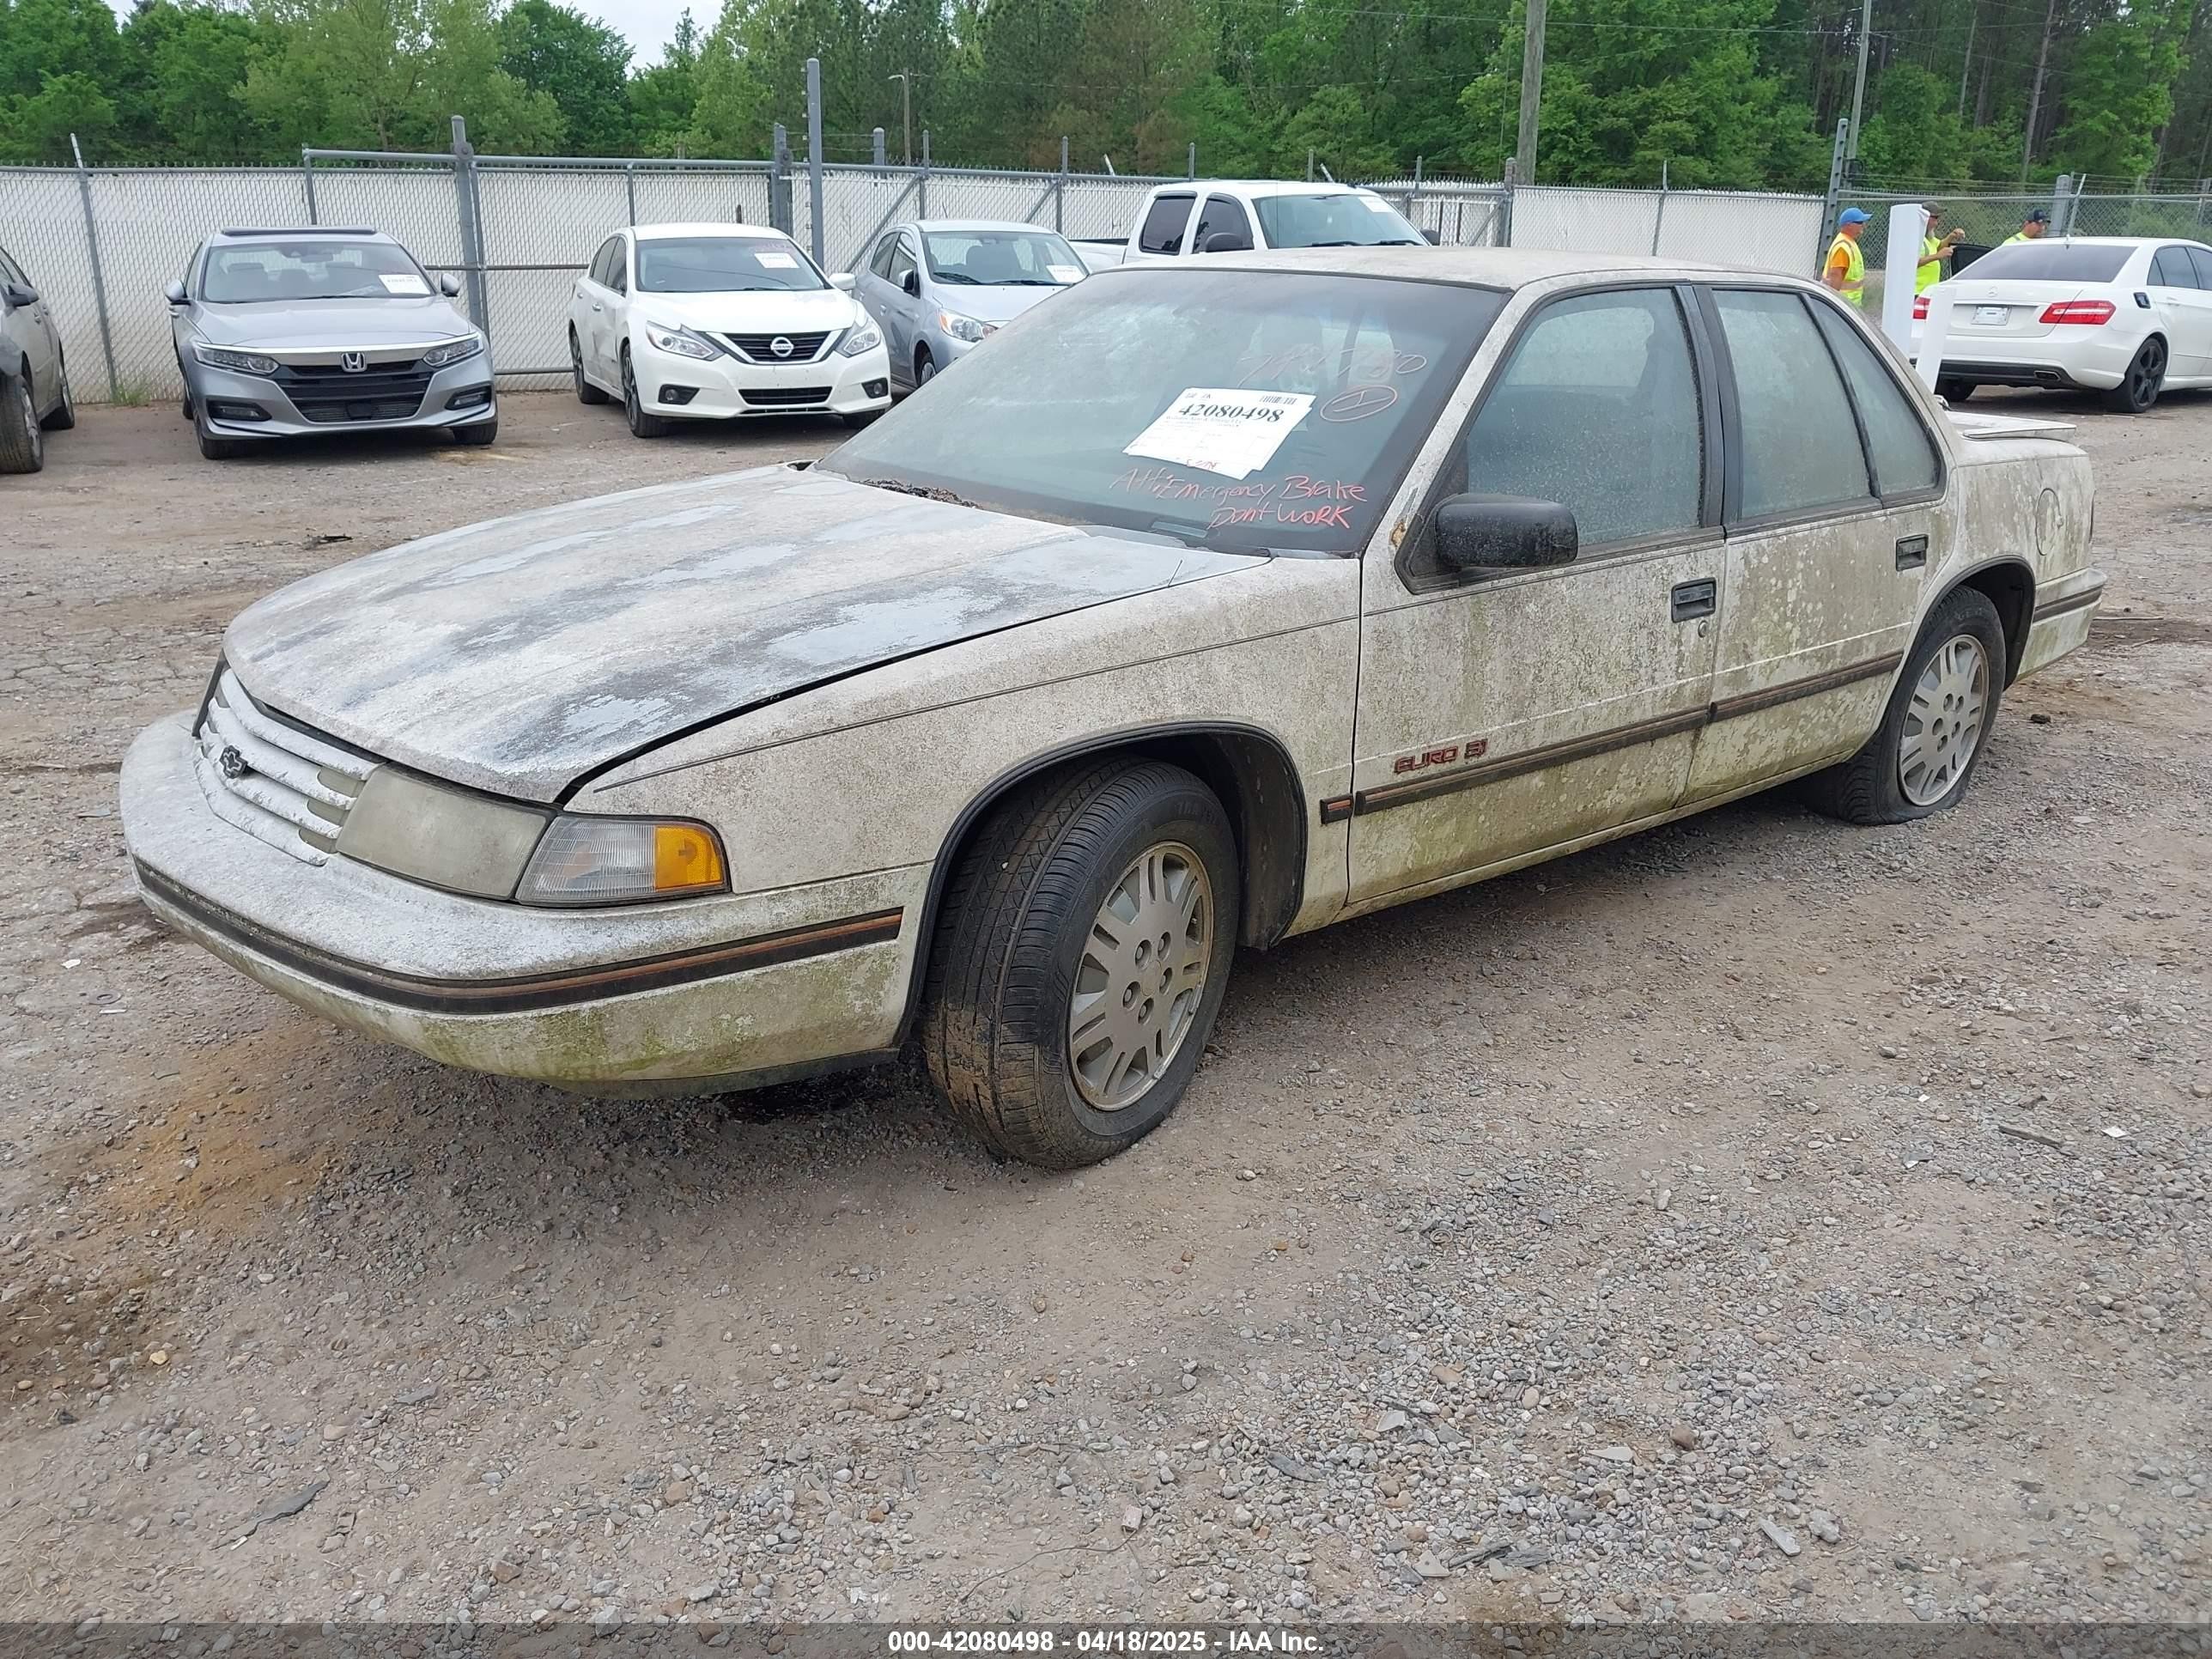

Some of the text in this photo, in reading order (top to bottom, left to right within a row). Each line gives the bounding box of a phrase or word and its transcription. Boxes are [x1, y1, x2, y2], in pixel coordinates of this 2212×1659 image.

[1178, 403, 1285, 422] 42080498
[1278, 474, 1368, 502] Brake
[1393, 745, 1459, 775] EURO
